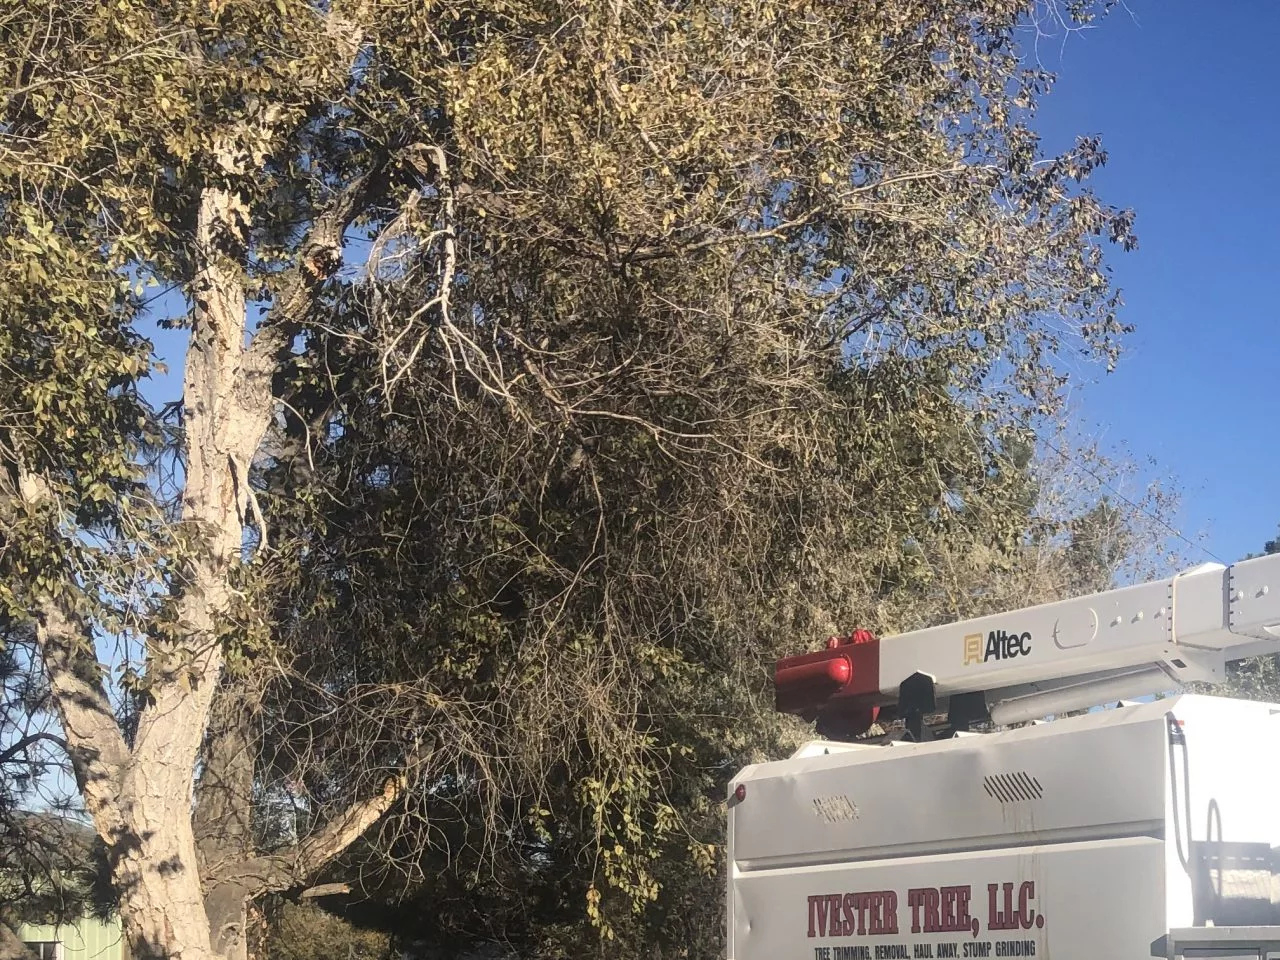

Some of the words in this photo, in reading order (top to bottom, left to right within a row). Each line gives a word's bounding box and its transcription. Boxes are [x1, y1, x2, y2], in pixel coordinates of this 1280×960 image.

[984, 630, 1032, 662] Altec
[807, 890, 899, 937] IVESTER
[908, 885, 979, 938] TREE,
[987, 881, 1045, 930] LLC.
[814, 947, 831, 960] TREE
[914, 944, 934, 959] HAUL
[963, 941, 992, 958] STUMP
[995, 940, 1036, 957] GRINDING
